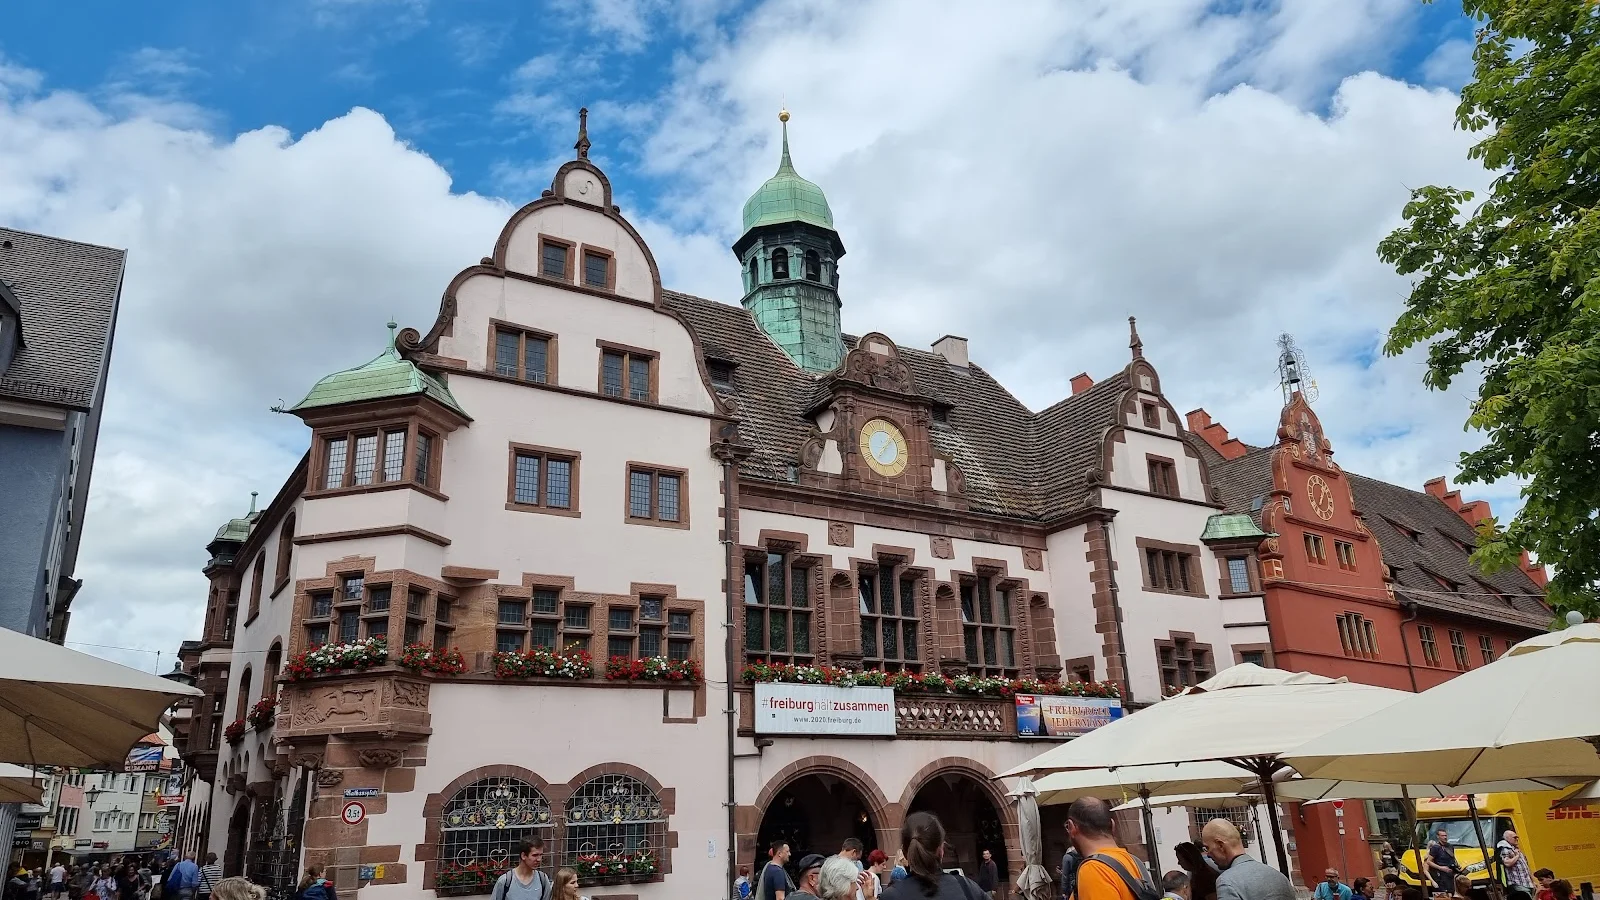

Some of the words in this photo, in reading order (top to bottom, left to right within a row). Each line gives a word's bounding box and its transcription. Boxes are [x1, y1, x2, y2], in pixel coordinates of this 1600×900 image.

[761, 696, 889, 712] #freiburghältzusammen
[1049, 705, 1110, 716] FREIBURGER
[793, 716, 862, 724] www.2020.freiburg.de
[346, 808, 360, 818] 3,5t
